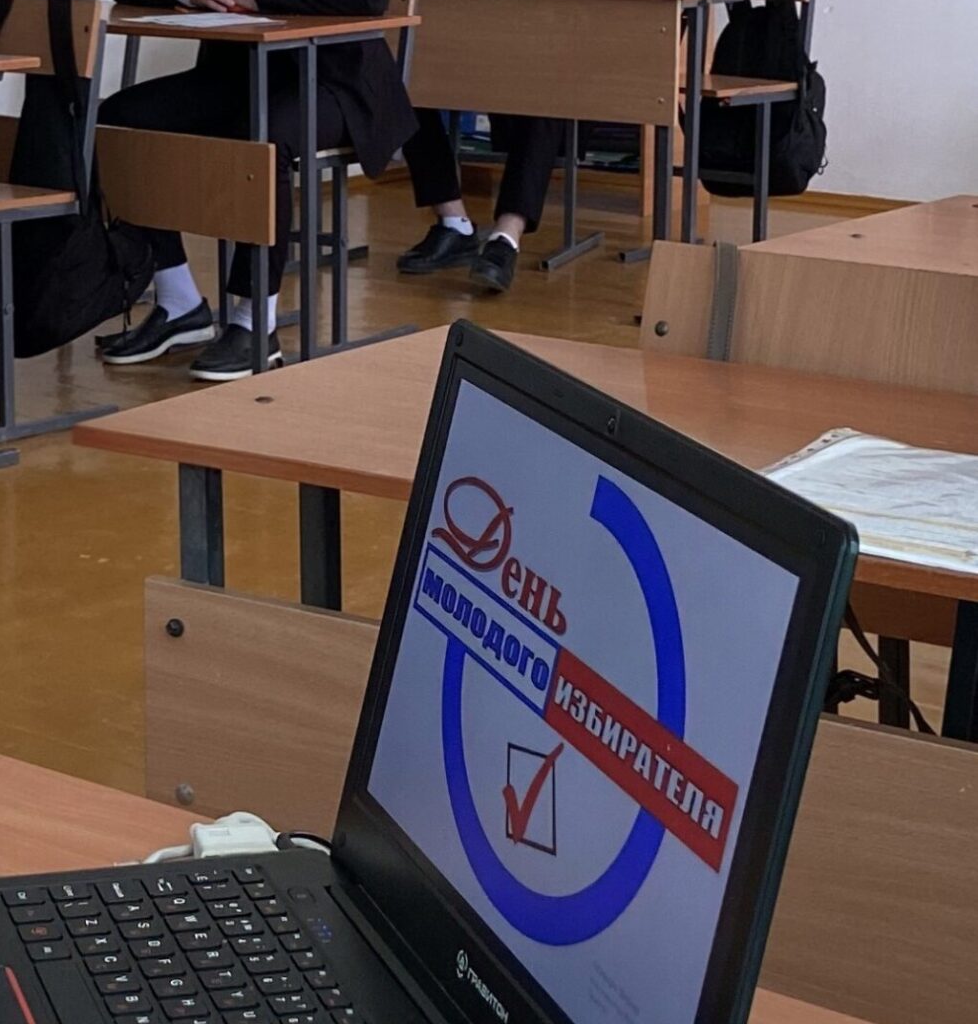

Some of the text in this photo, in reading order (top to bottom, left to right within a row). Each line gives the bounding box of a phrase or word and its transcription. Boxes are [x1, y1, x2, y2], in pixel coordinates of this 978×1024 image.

[423, 567, 550, 691] МОЛОДОГО
[431, 476, 567, 636] День
[554, 675, 724, 840] ИЗБИРАТЕЛЯ
